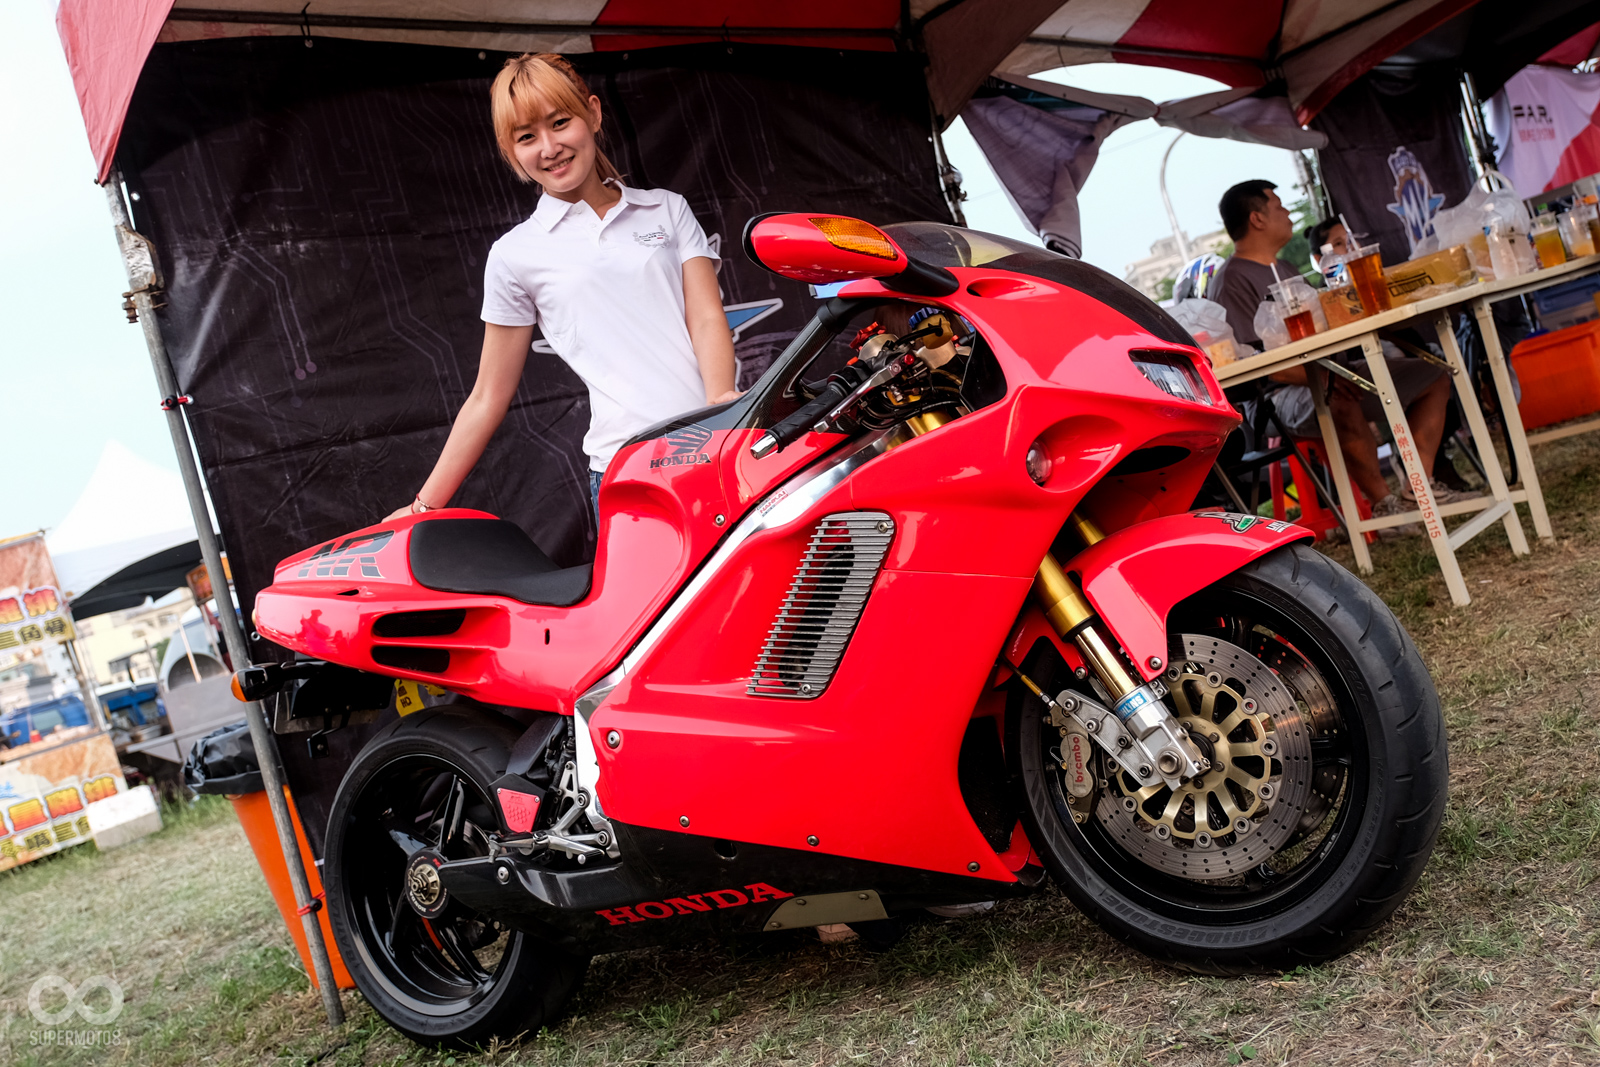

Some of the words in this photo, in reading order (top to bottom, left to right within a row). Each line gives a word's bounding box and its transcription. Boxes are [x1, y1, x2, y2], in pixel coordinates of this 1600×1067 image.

[649, 453, 711, 469] HONDA
[1409, 472, 1441, 539] 0921215115
[1072, 736, 1084, 783] brembo
[594, 882, 795, 926] HONDA
[1102, 894, 1269, 945] BRIDGESTONE
